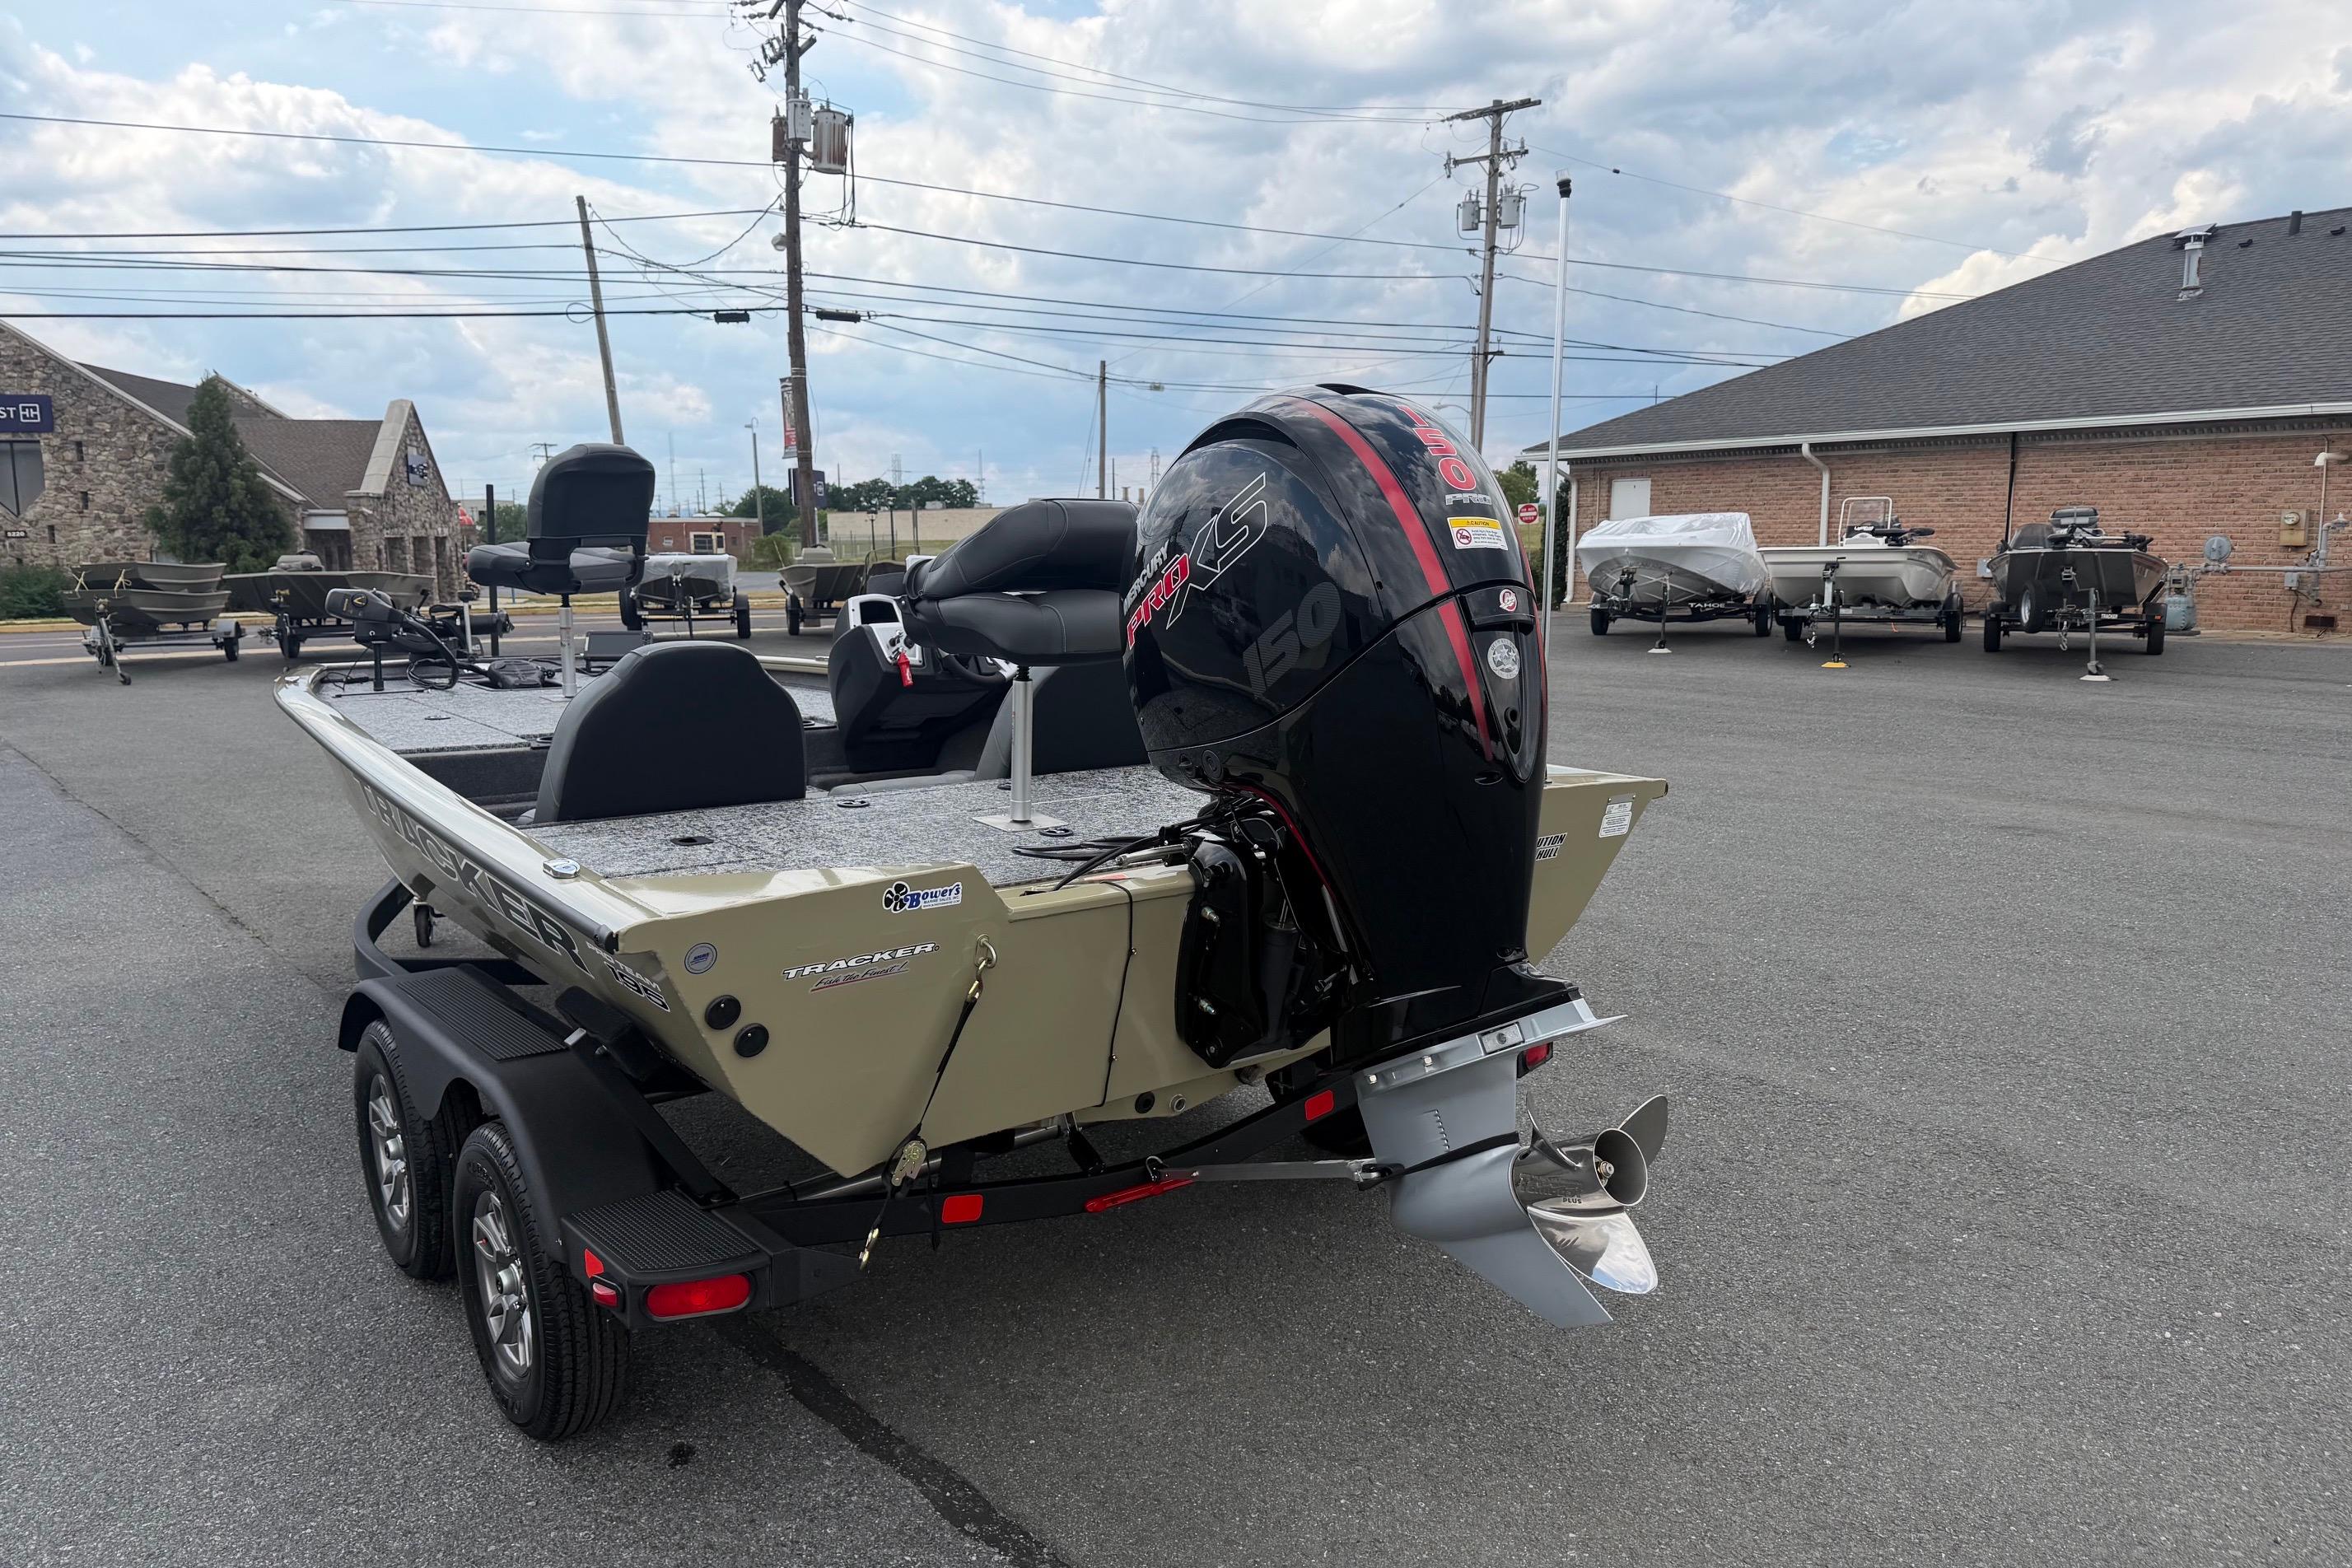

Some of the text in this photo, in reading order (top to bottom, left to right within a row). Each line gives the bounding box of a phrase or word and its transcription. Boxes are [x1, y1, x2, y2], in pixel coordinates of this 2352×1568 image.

[1395, 404, 1477, 491] 150
[1445, 492, 1491, 505] PRO
[1123, 539, 1169, 616] MERCURY
[1127, 471, 1267, 651] PRO XS
[1243, 581, 1342, 699] 150
[352, 774, 595, 980] TRACKER
[1536, 847, 1559, 860] HULL
[586, 940, 661, 992] PRO TEAM
[604, 960, 670, 1013] 195
[783, 942, 936, 980] TRACKER
[815, 977, 841, 987] Fish
[842, 973, 860, 982] the
